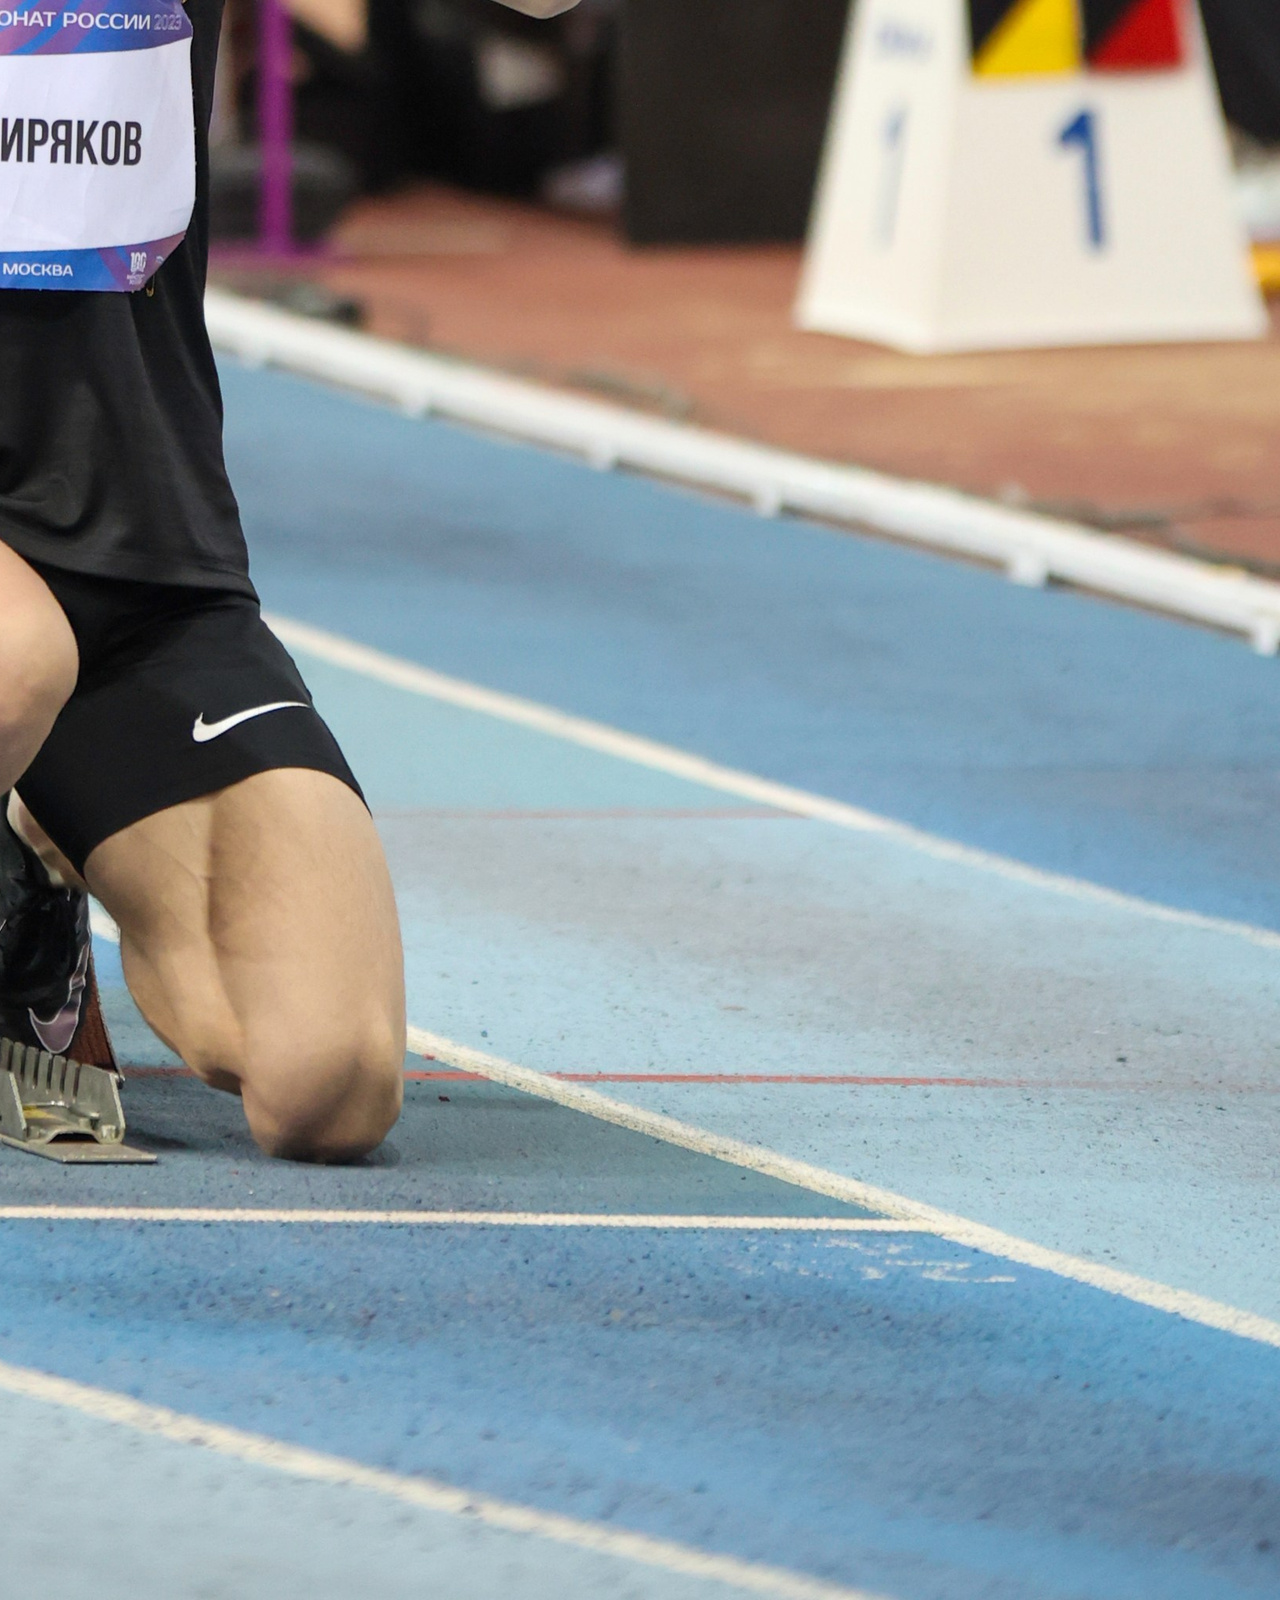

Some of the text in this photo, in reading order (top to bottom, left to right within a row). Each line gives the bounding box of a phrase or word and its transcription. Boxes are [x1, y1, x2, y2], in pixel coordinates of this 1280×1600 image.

[62, 11, 151, 31] РОССИИ
[153, 13, 182, 31] 2023
[1057, 106, 1106, 250] 1
[2, 262, 74, 277] МОСКВА
